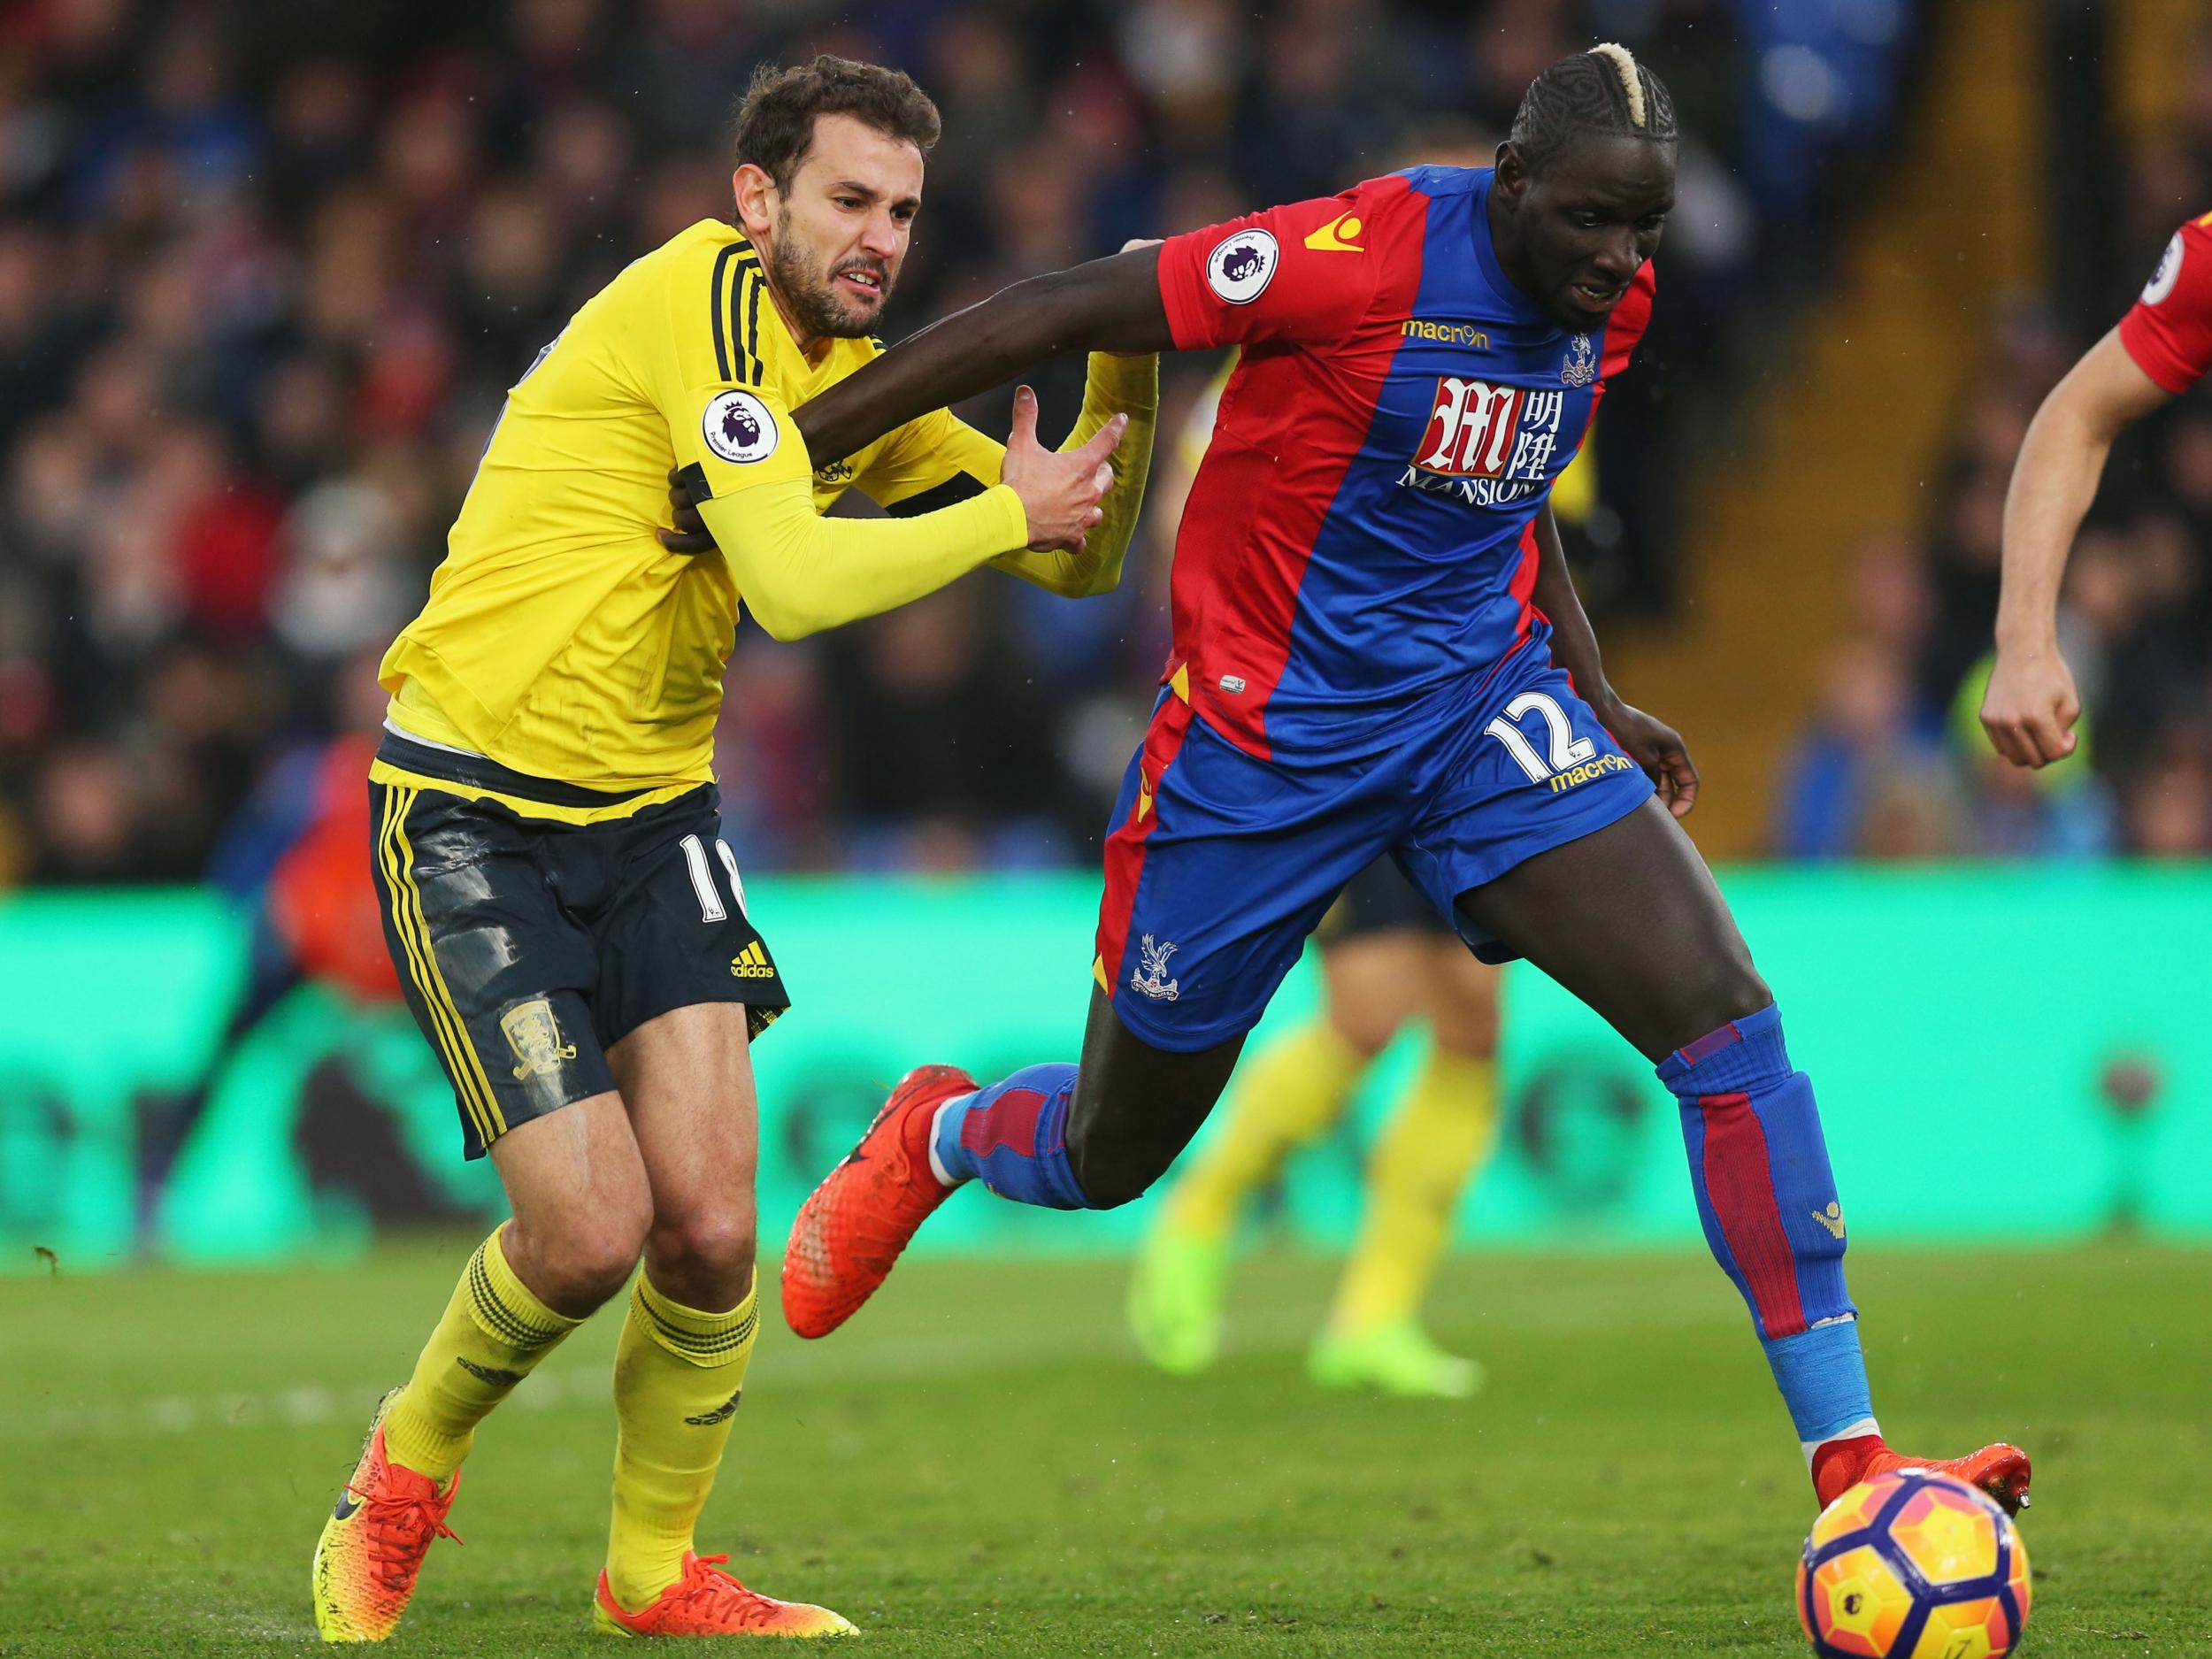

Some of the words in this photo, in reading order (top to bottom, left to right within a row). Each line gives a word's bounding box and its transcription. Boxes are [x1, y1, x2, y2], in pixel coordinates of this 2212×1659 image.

[1401, 320, 1490, 350] macron
[710, 431, 727, 452] Premier
[727, 449, 754, 459] League
[1394, 464, 1537, 506] MANSION
[1484, 691, 1596, 785] 12
[1549, 754, 1634, 793] macron
[730, 964, 774, 979] adidas
